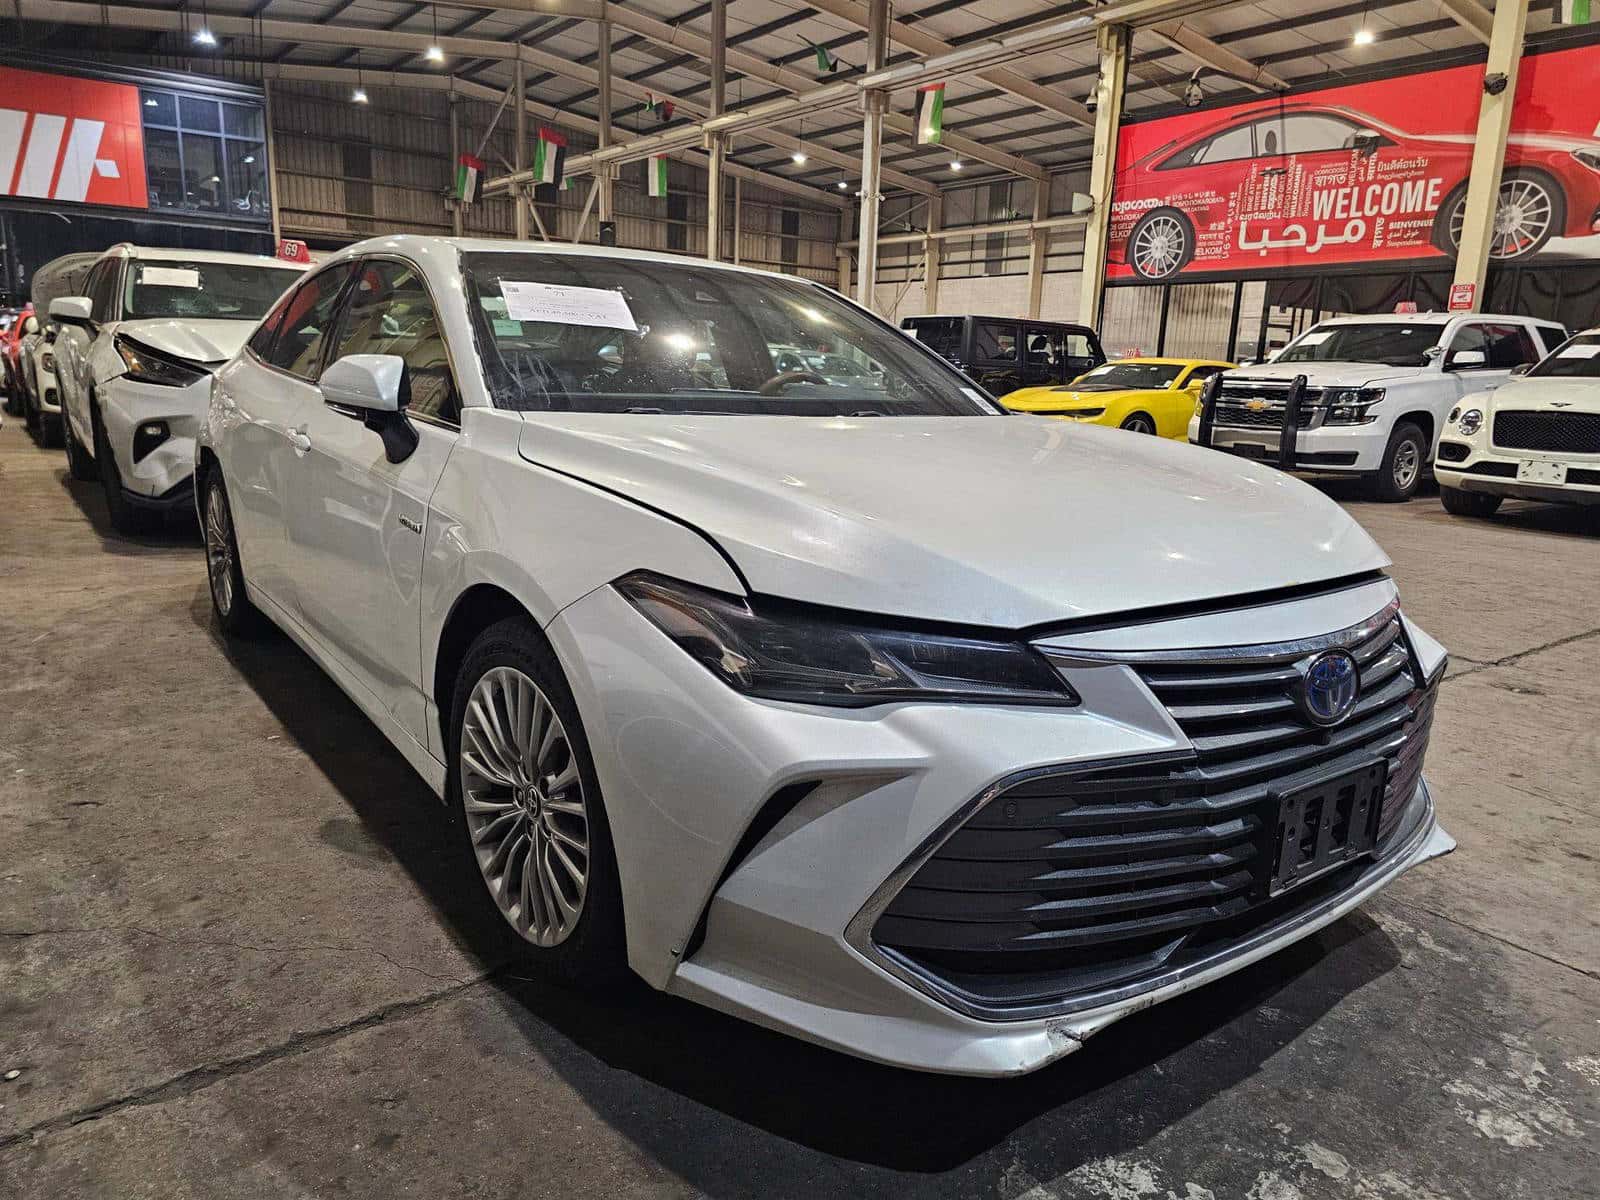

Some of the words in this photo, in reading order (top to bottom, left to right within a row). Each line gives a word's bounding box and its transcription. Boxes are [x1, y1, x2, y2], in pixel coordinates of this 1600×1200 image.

[1313, 178, 1443, 221] WELCOME
[285, 242, 298, 258] 69
[1238, 219, 1367, 257] مرحبا
